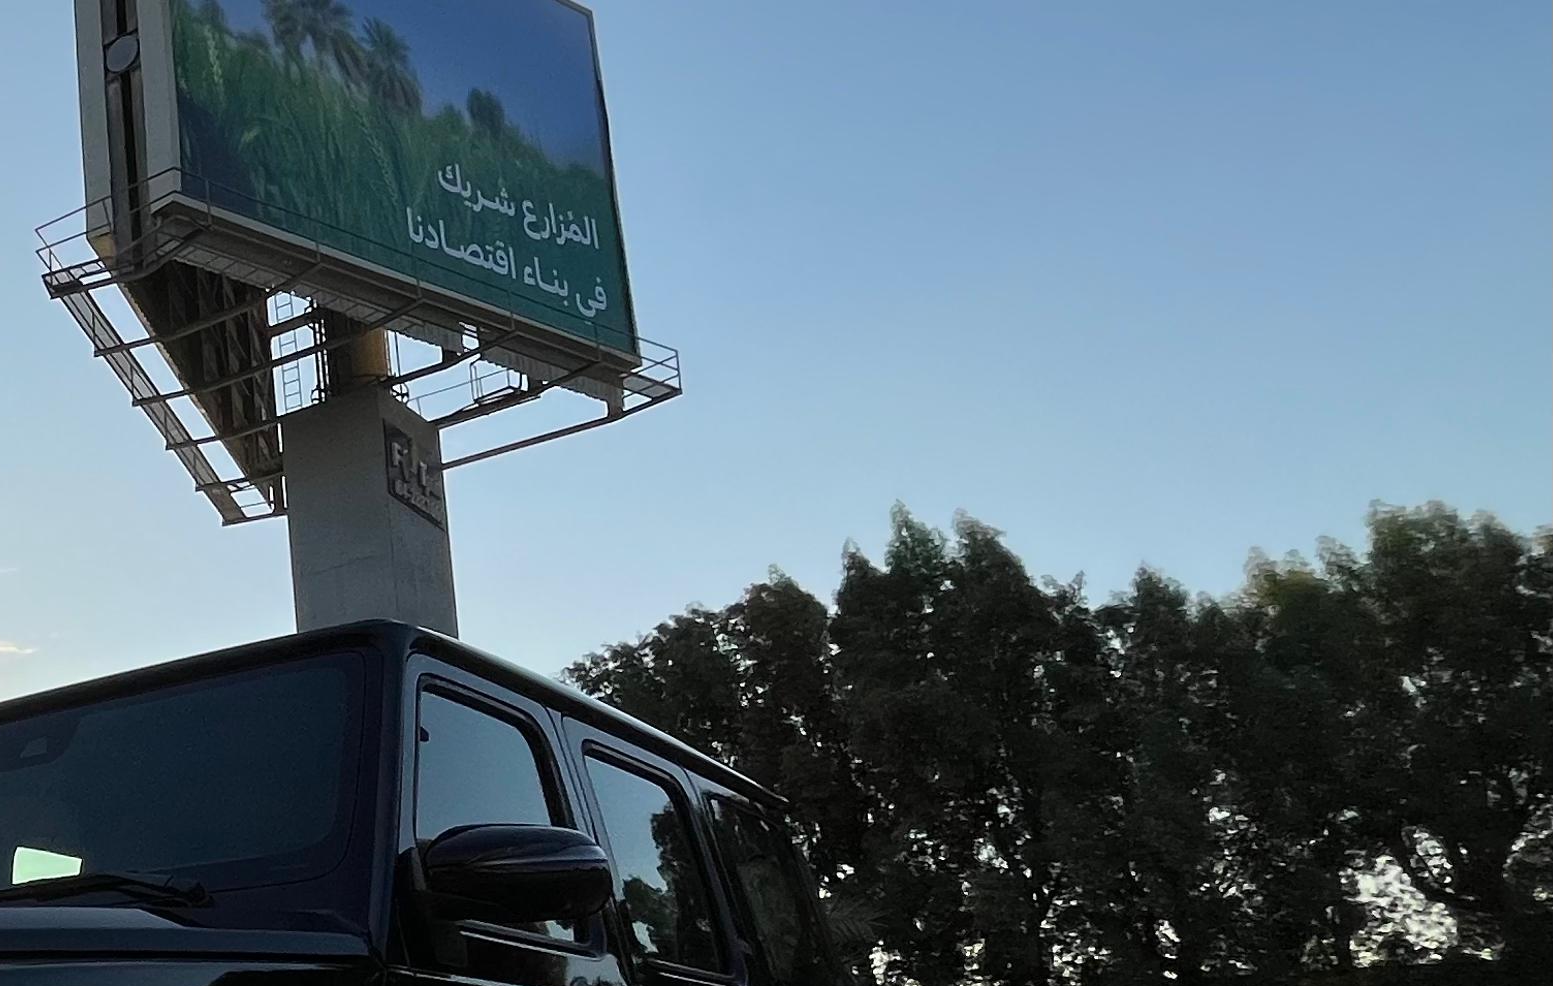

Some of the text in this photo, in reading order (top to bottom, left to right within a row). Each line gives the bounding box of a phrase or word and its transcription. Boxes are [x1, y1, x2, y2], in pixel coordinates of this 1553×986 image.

[437, 163, 516, 217] شريك
[405, 206, 517, 280] اقتصادنا
[523, 256, 569, 306] بناء
